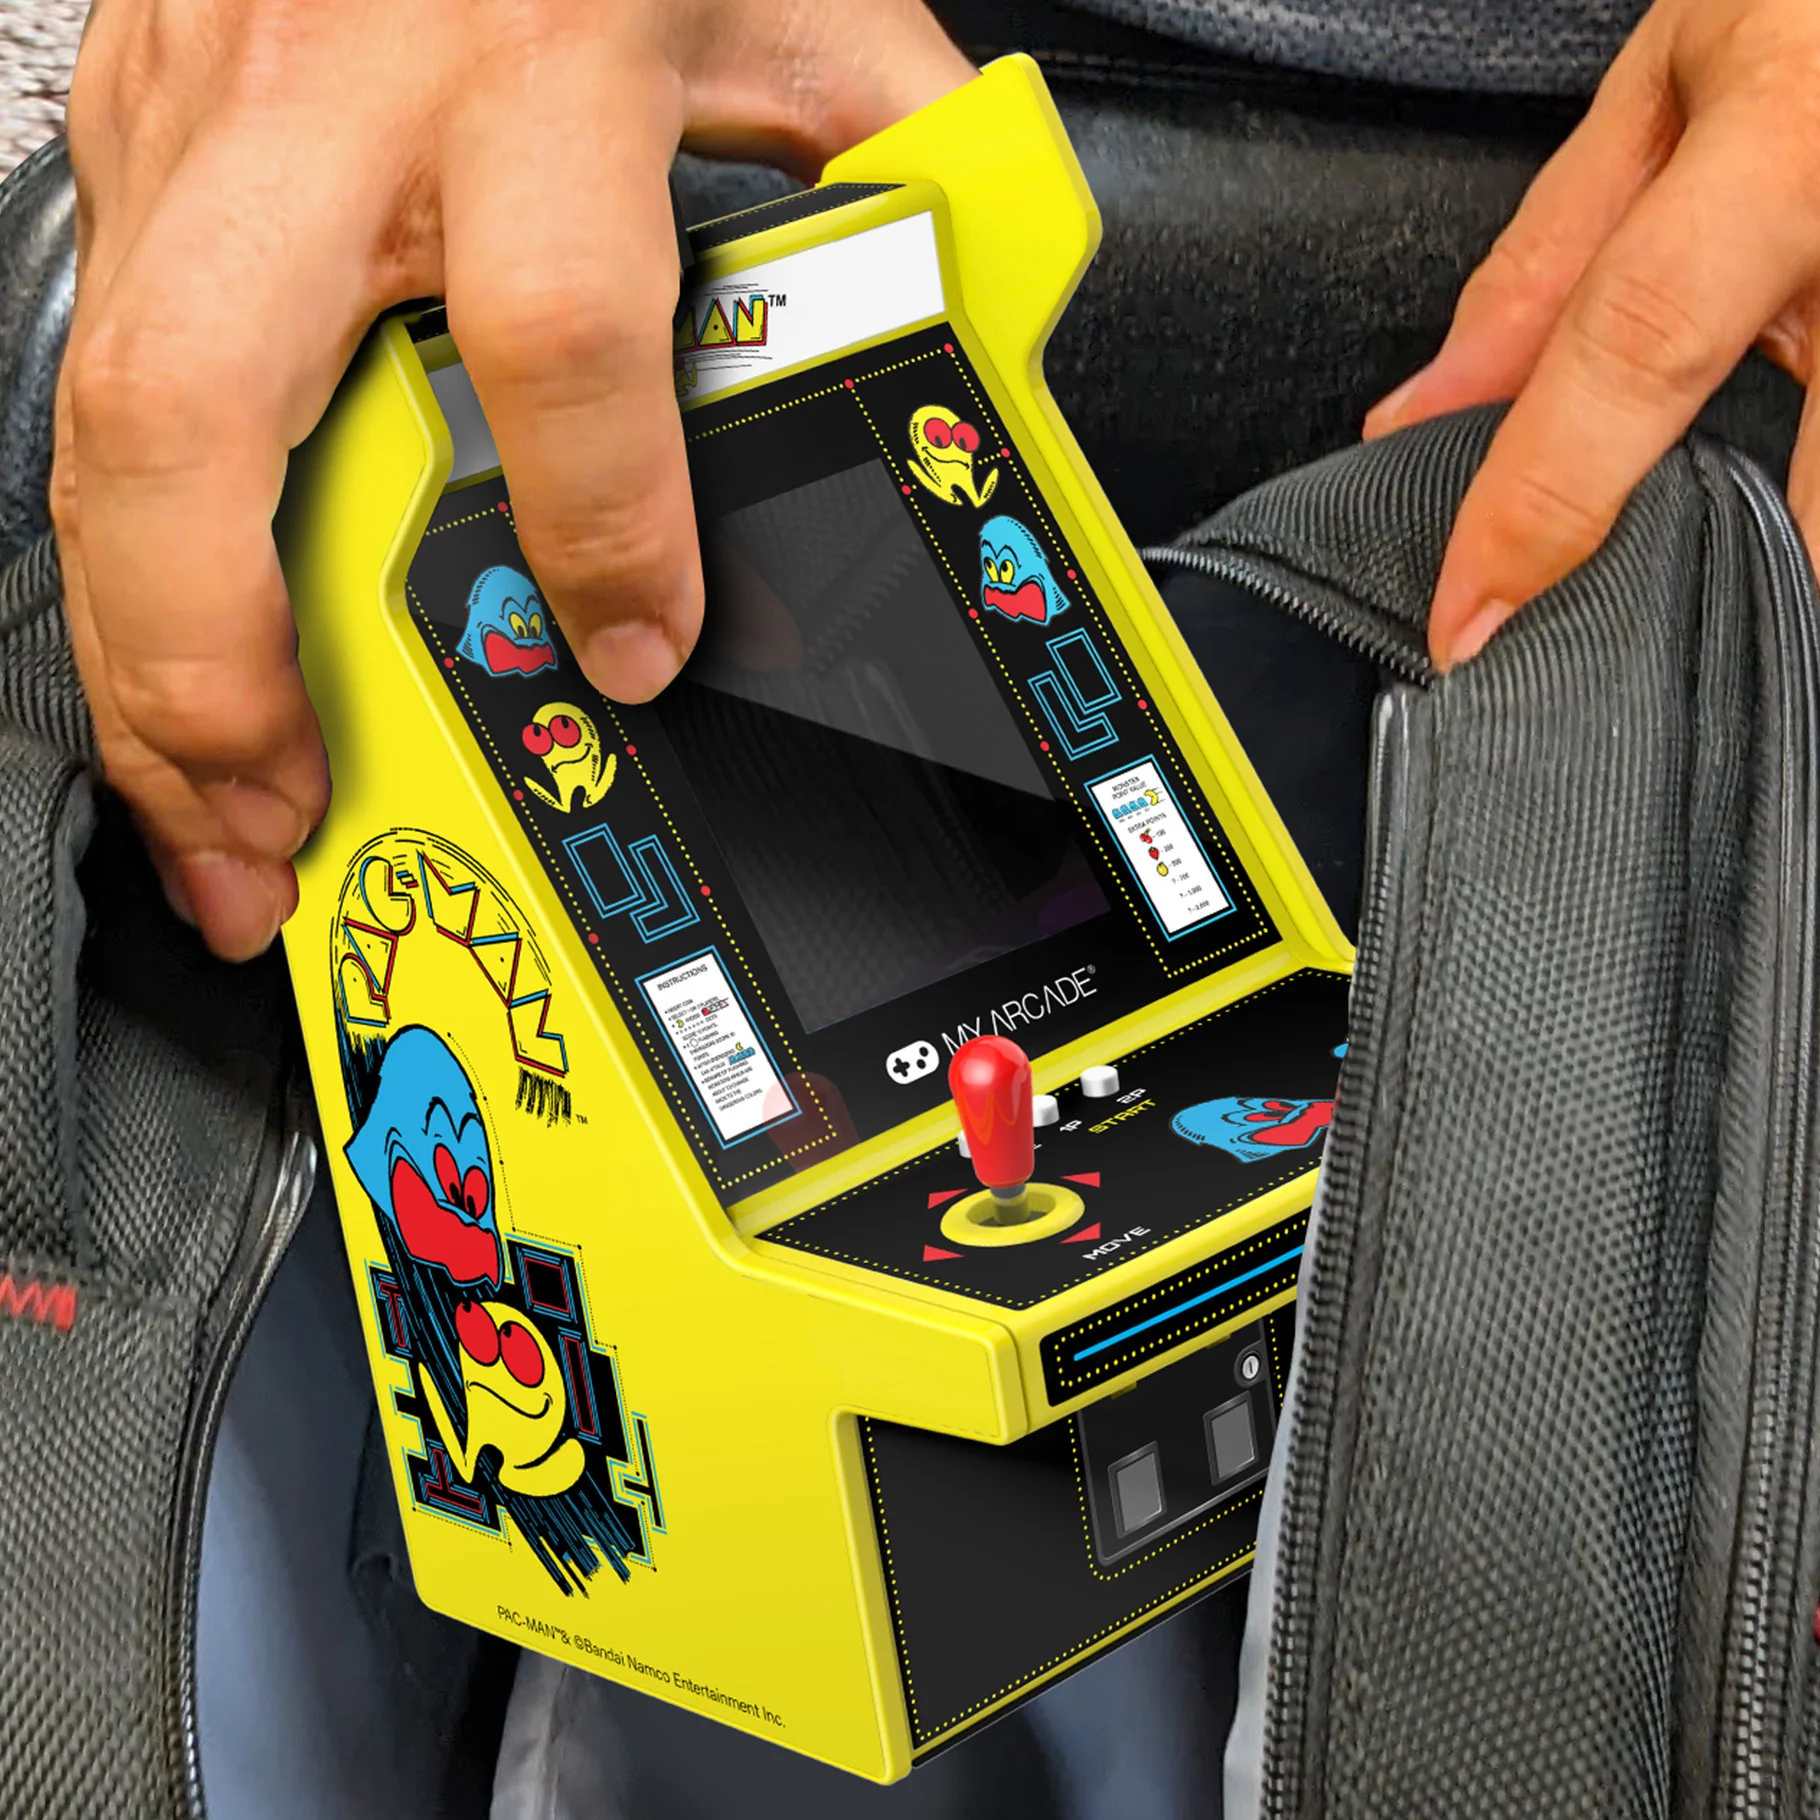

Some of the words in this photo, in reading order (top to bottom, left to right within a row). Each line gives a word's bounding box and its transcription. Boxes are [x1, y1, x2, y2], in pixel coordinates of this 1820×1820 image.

[336, 850, 569, 1079] PAC-MAN
[657, 964, 708, 991] INSTRUCTIONS
[1088, 1099, 1156, 1134] START
[1082, 1226, 1151, 1261] MOVE
[627, 1655, 671, 1683] Namco
[673, 1672, 760, 1718] Entertainment
[762, 1706, 786, 1728] Inc.
